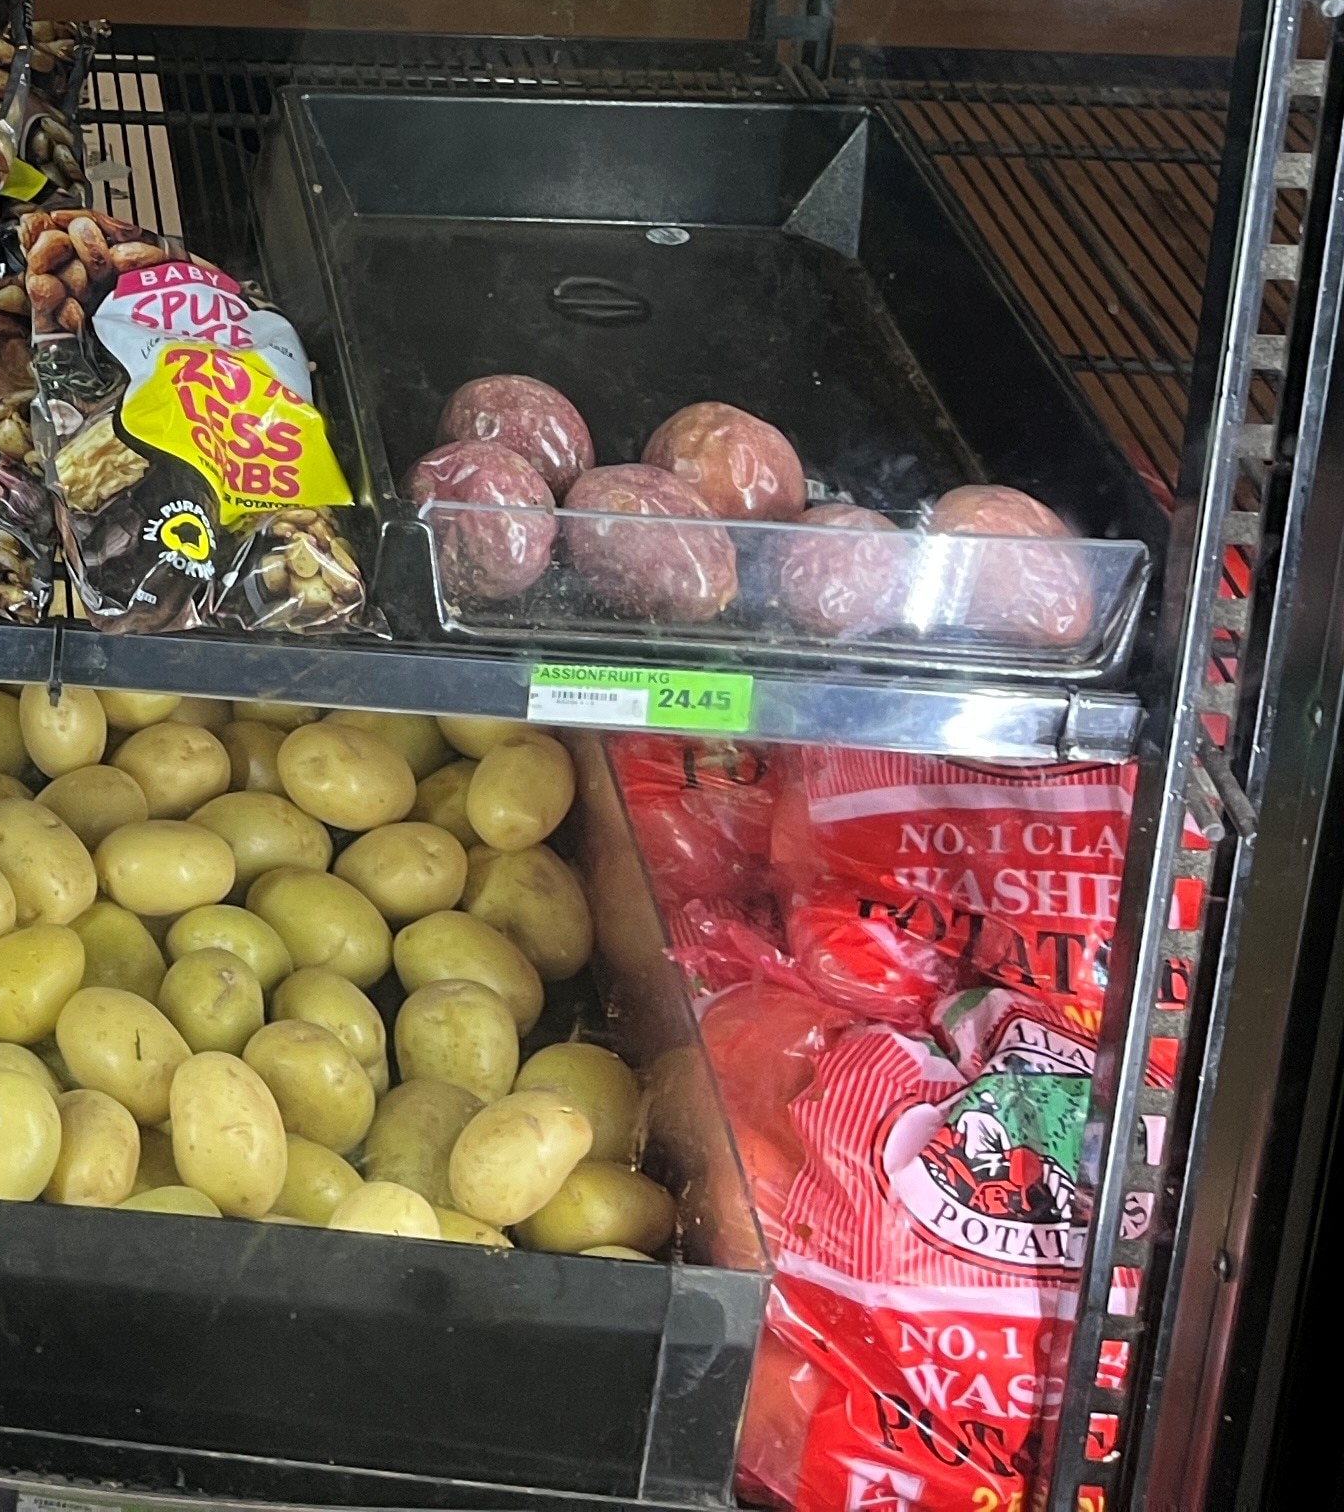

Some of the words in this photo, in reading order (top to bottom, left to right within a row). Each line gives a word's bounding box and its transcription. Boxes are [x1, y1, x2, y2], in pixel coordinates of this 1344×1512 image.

[139, 265, 220, 287] BABY
[131, 290, 249, 330] SPUD
[175, 385, 303, 462] LESS
[191, 425, 300, 499] CARBS
[143, 518, 164, 541] ALL
[533, 666, 642, 684] PASSIONFRUIT
[648, 672, 670, 684] KG
[658, 688, 731, 711] 24.45
[896, 824, 975, 856] NO.
[987, 825, 1007, 854] 1
[1021, 821, 1125, 860] CLA
[897, 1320, 988, 1361] NO.
[1001, 1326, 1023, 1359] 1
